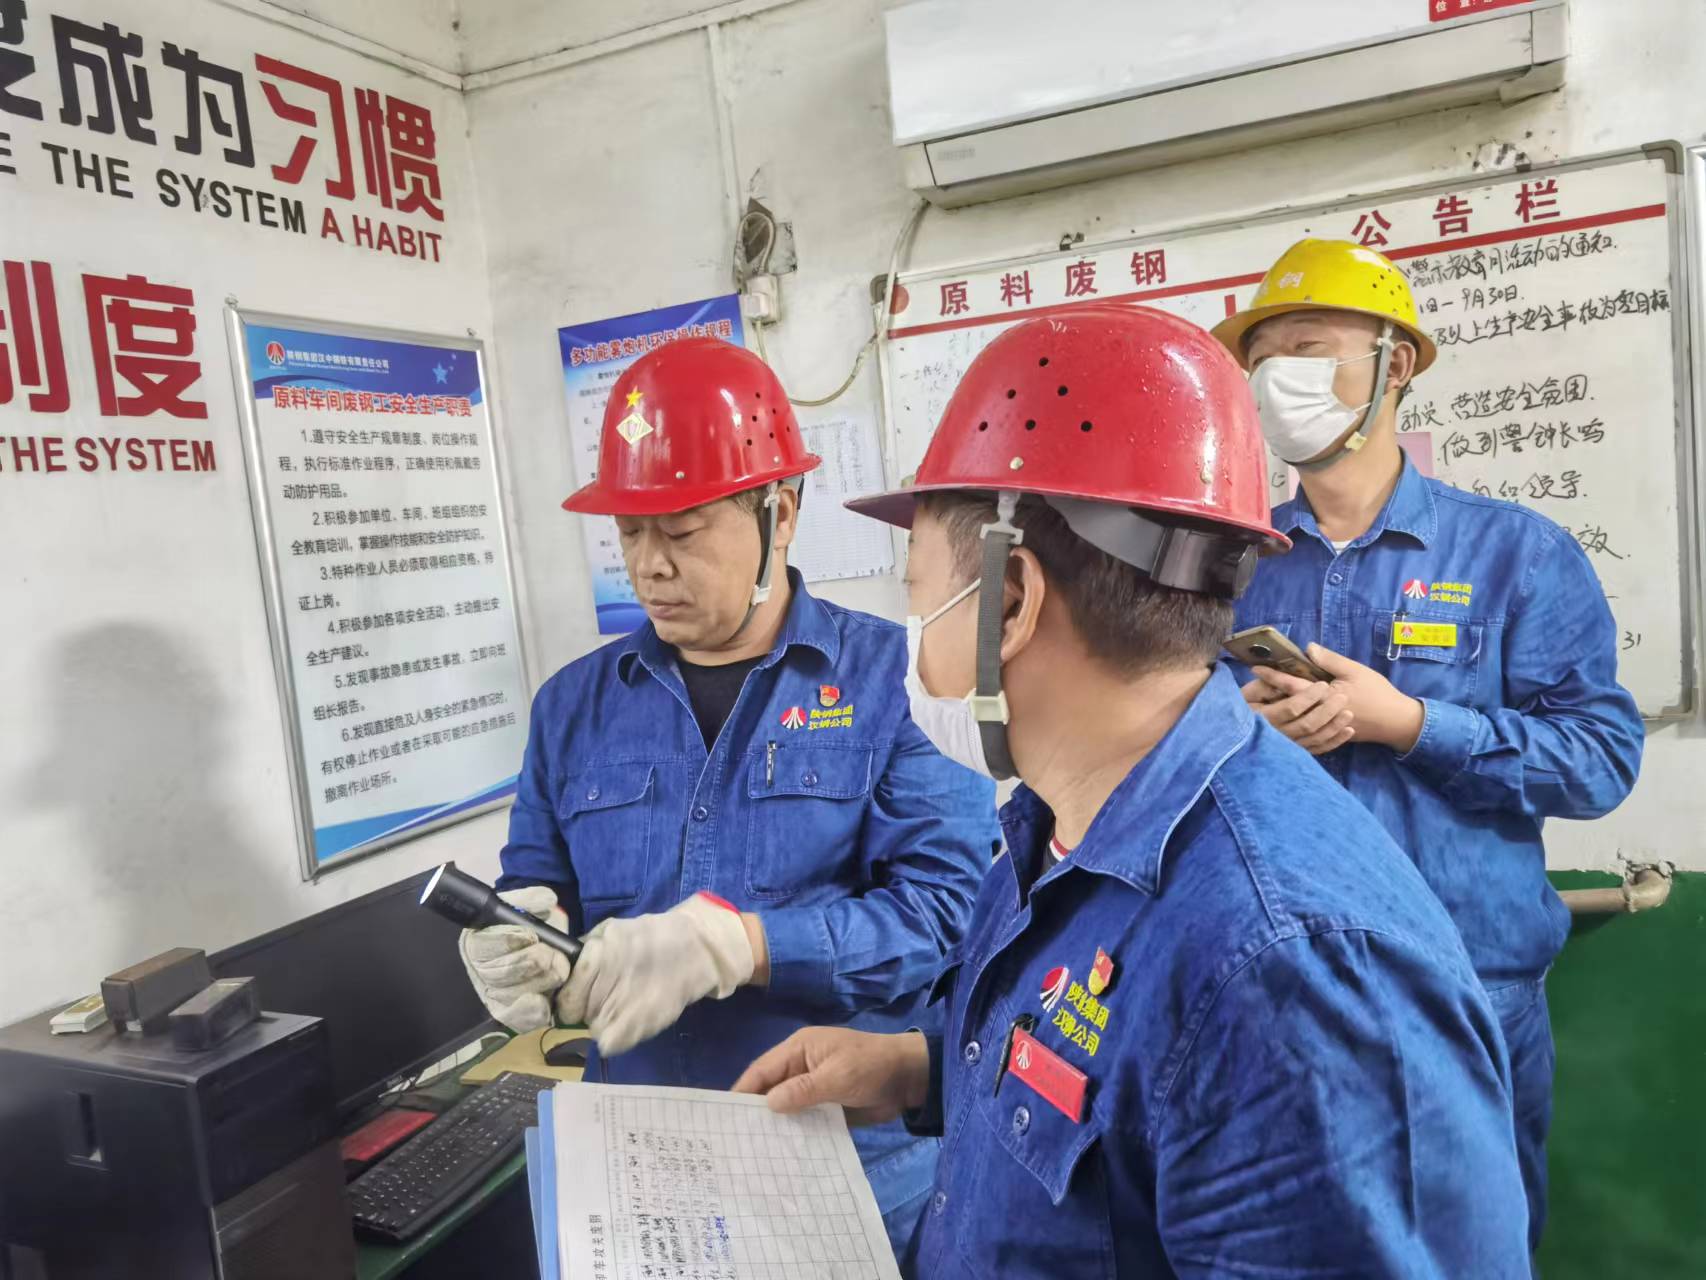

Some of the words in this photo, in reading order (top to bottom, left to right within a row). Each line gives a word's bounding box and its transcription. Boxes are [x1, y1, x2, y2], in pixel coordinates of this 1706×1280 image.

[41, 142, 133, 199] THE
[156, 168, 307, 234] SYSTEM
[320, 207, 344, 242] A
[352, 214, 442, 263] HABIT
[939, 249, 1167, 316] 原料废钢
[1351, 178, 1561, 248] 公告栏
[272, 385, 473, 417] 原料车间废钢工安全生产职责
[75, 437, 217, 472] SYSTEM
